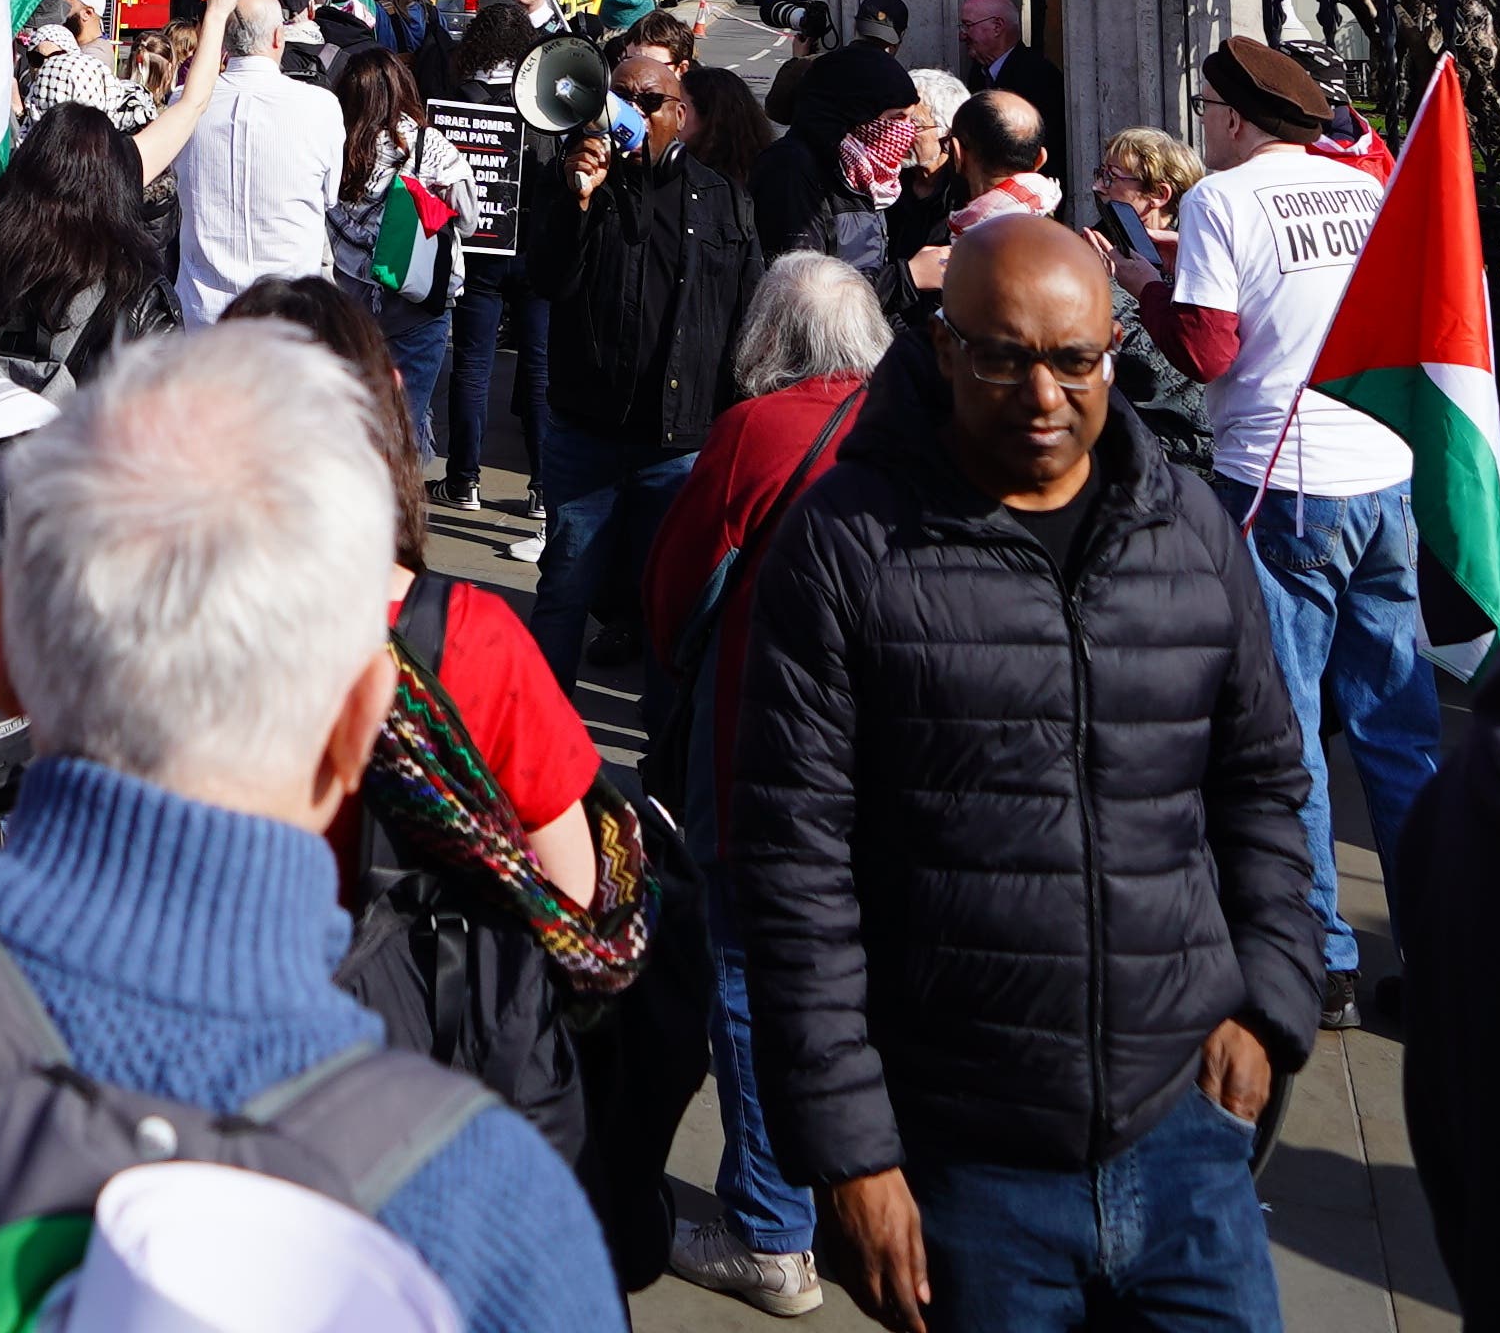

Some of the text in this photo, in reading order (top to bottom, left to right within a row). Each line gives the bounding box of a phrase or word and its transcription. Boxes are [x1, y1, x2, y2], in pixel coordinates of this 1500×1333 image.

[435, 115, 516, 133] ISRAEL BOMBS.
[445, 129, 502, 146] USA PAYS.
[469, 152, 509, 169] MANY
[475, 170, 499, 183] DID
[1286, 224, 1319, 261] IN
